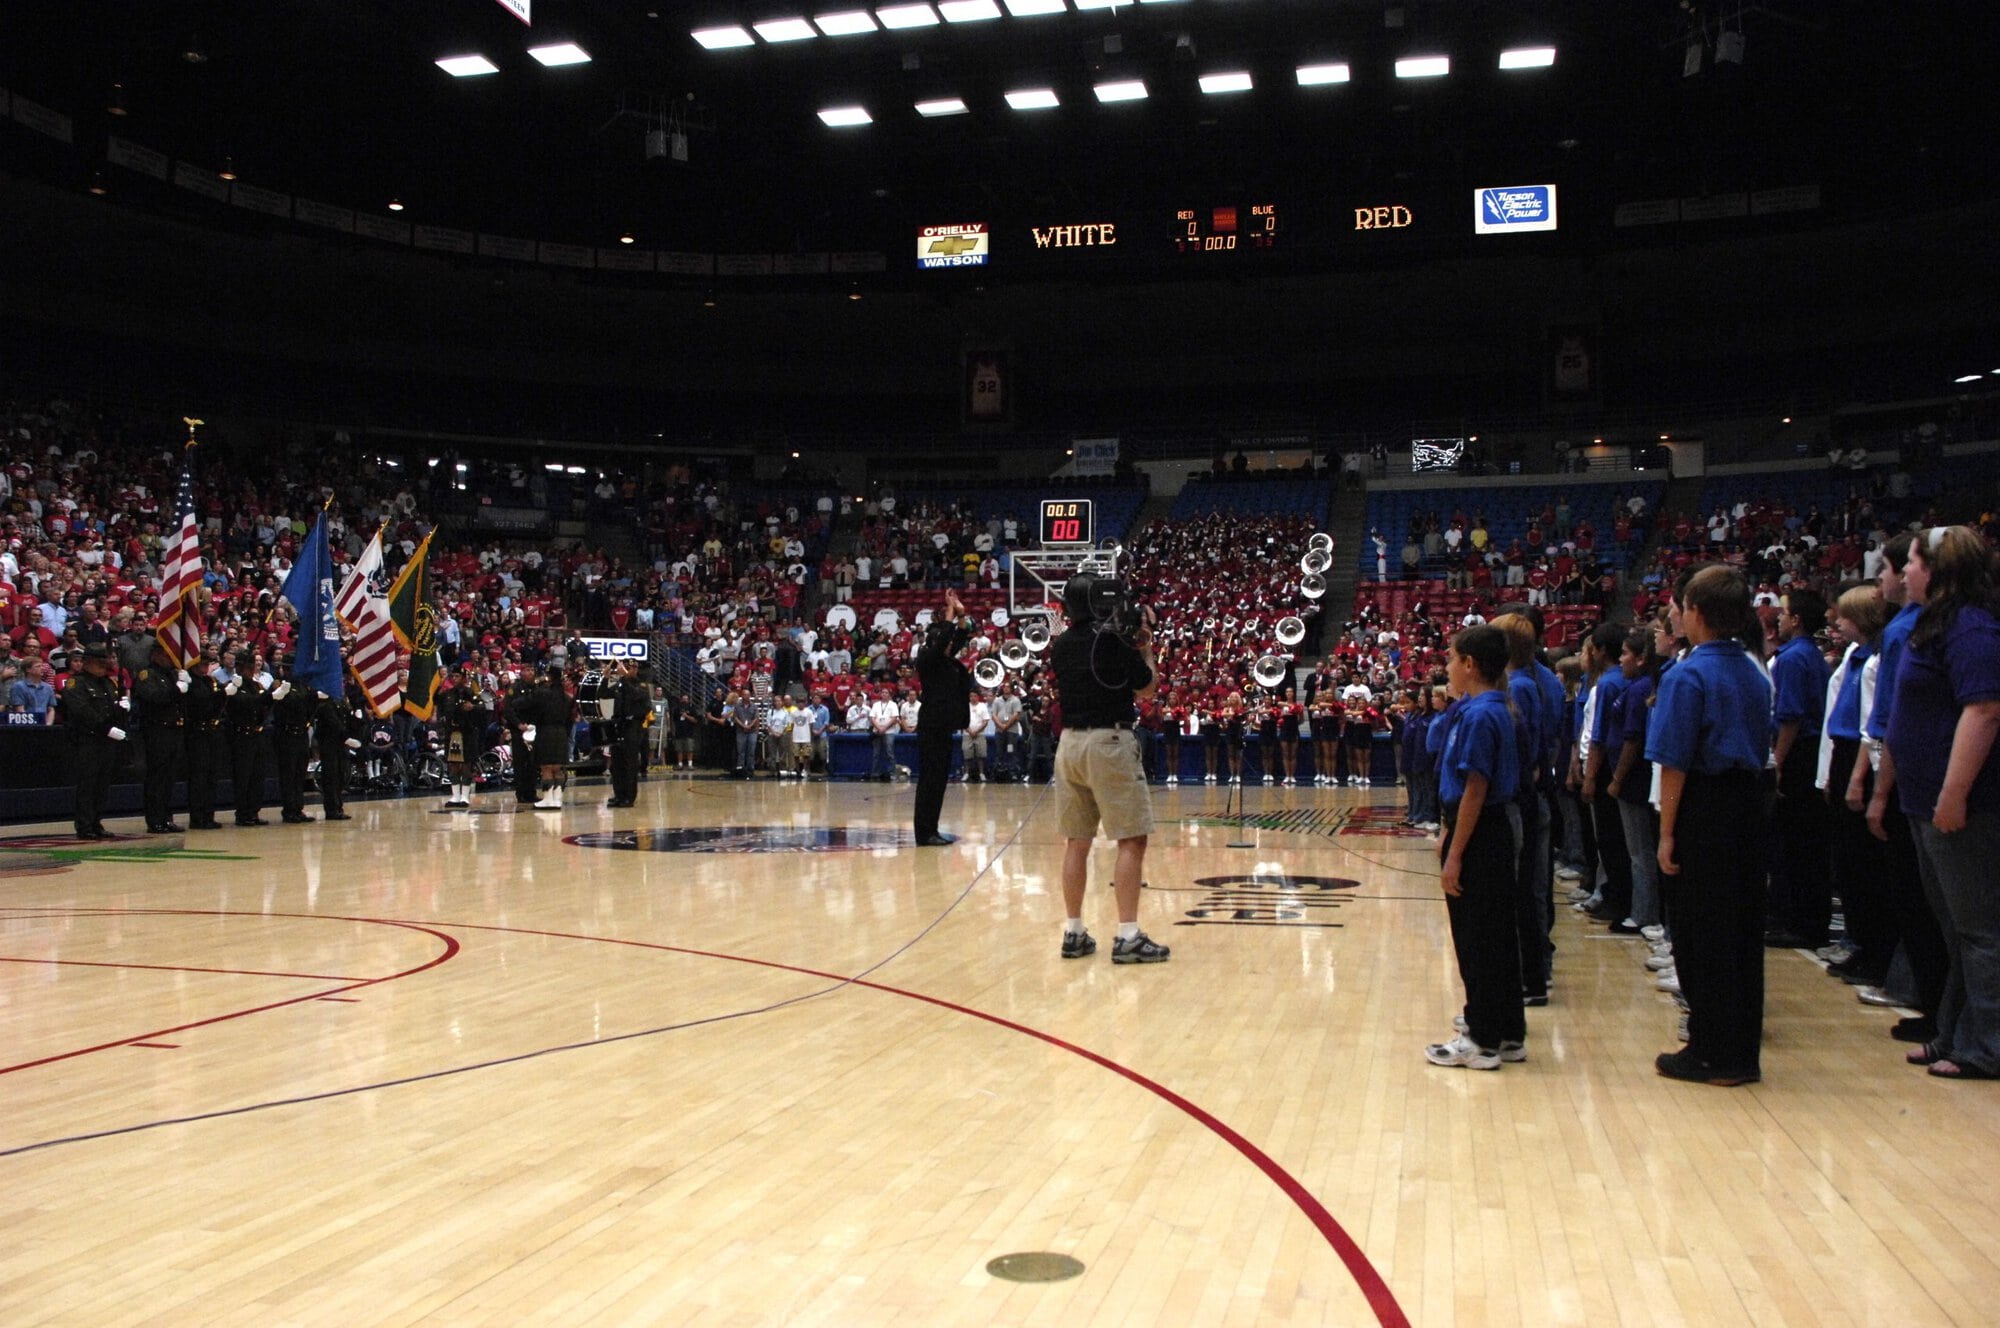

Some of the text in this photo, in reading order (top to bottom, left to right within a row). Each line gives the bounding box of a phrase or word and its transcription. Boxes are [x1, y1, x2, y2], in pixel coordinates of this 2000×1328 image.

[1498, 192, 1535, 201] Tucson
[1252, 204, 1275, 215] BLUE
[1502, 199, 1542, 209] Electric
[1177, 210, 1194, 220] RED
[1354, 205, 1413, 230] RED
[1506, 207, 1543, 219] Power
[923, 224, 982, 237] O'RIELLY
[1031, 223, 1116, 249] WHITE
[1205, 234, 1237, 251] 00.0
[923, 255, 983, 267] WATSON
[977, 380, 997, 393] 32
[1047, 504, 1077, 517] 00.0
[1052, 519, 1080, 540] 00
[587, 641, 646, 657] EICO
[8, 712, 38, 725] POSS.
